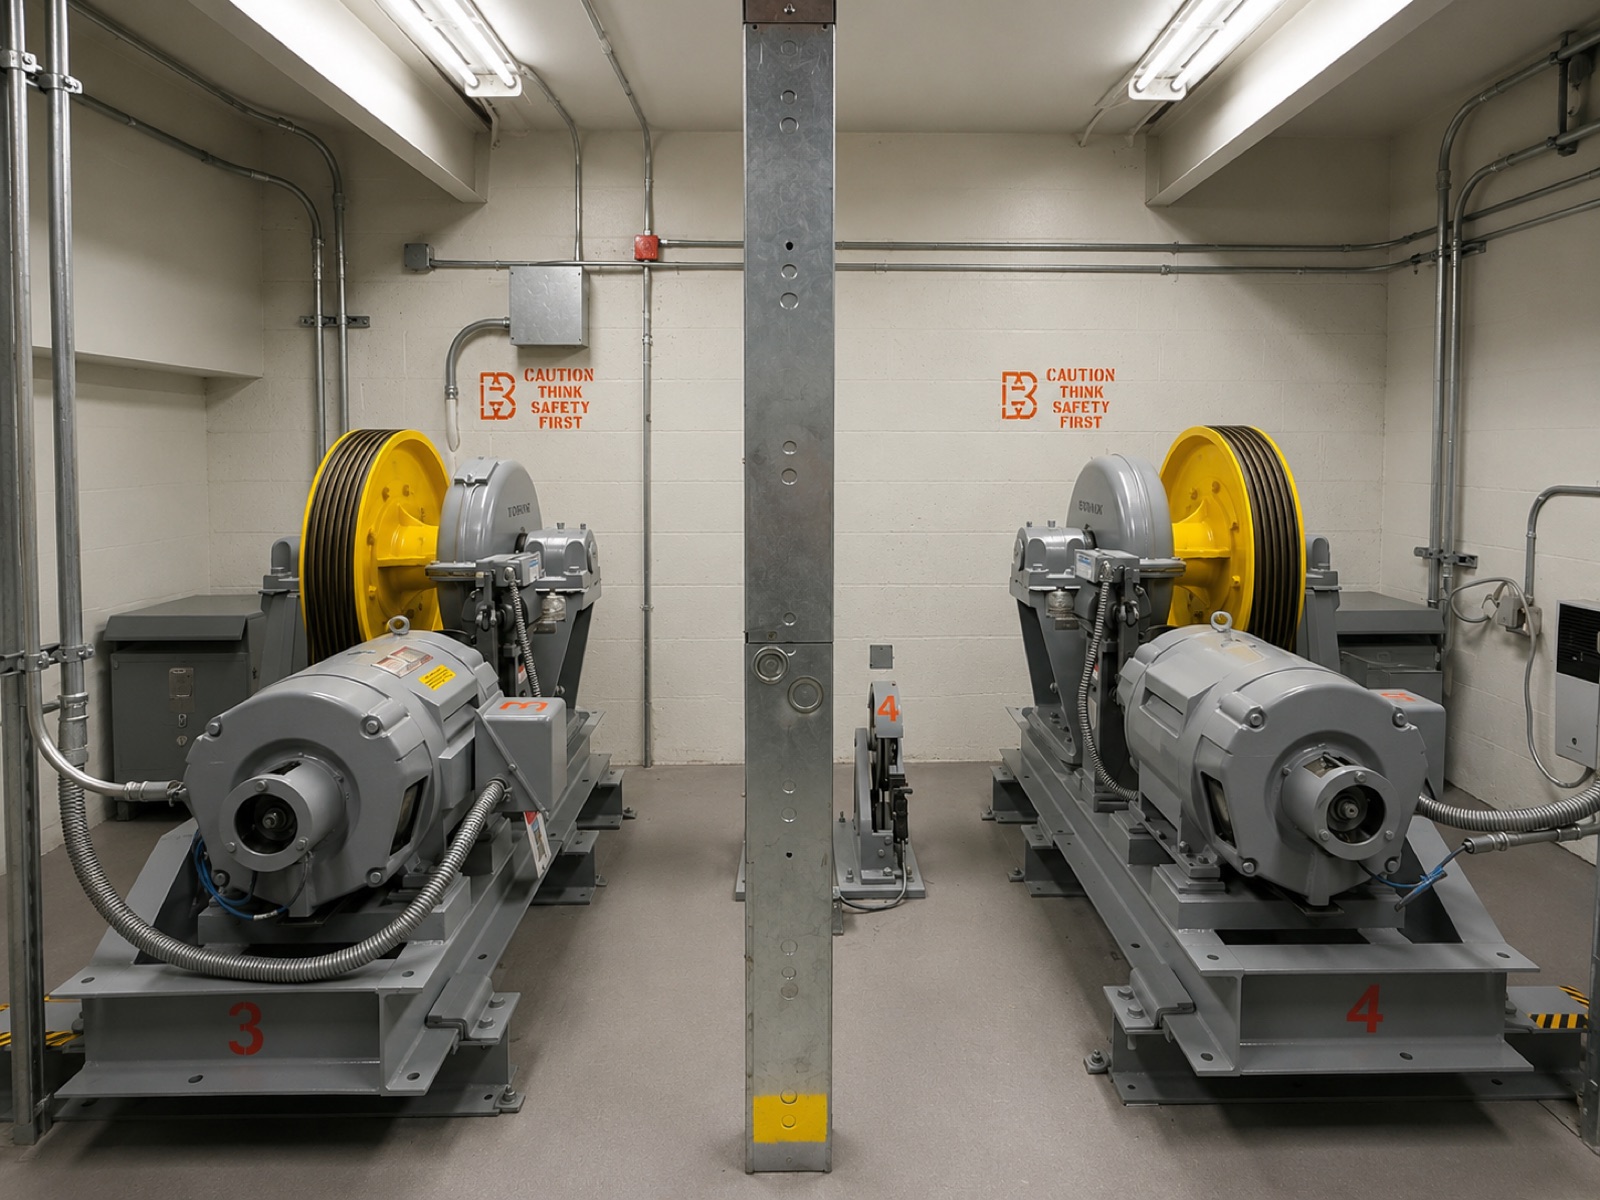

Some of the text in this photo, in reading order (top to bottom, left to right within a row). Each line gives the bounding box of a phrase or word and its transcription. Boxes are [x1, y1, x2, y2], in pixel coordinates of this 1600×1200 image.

[524, 367, 595, 382] CAUTION
[1046, 367, 1116, 382] CAUTION
[537, 385, 583, 399] THINK
[1059, 385, 1104, 399] THINK
[531, 401, 590, 414] SAFETY
[1053, 400, 1110, 414] SAFETY
[539, 415, 583, 430] FIRST
[1060, 415, 1102, 429] FIRST
[499, 701, 548, 712] 3
[877, 694, 900, 723] 4
[1346, 984, 1384, 1034] 4
[228, 1001, 264, 1056] 3
